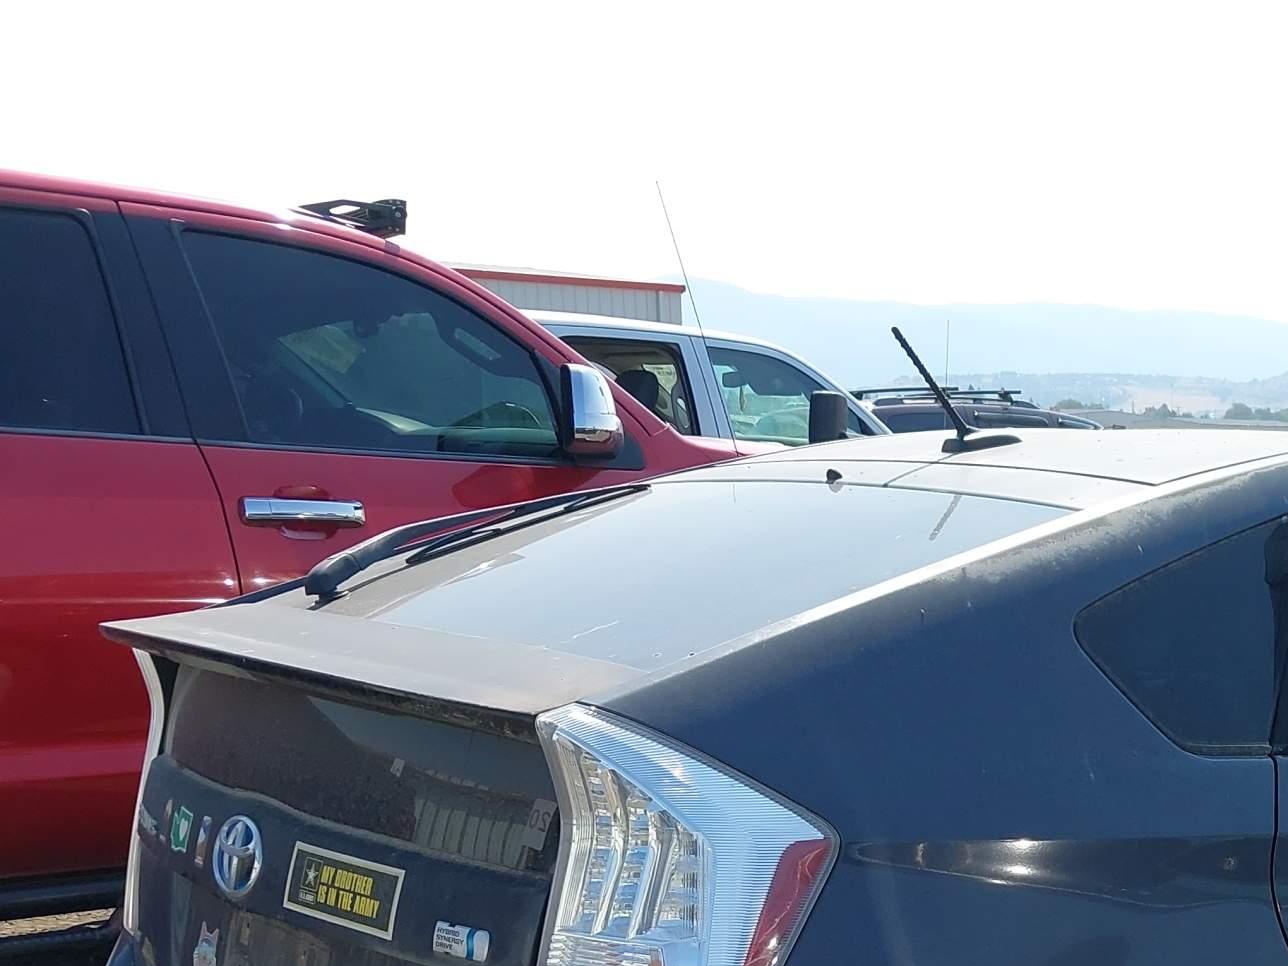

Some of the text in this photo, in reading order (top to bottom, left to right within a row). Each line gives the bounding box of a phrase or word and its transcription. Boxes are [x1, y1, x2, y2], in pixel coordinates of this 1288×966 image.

[320, 865, 373, 896] MY BROTHER
[317, 885, 327, 904] IS
[326, 887, 338, 907] IN
[337, 890, 354, 912] THE
[353, 895, 380, 919] ARMY
[435, 934, 464, 945] SYNERGY
[435, 941, 453, 951] DRIVE
